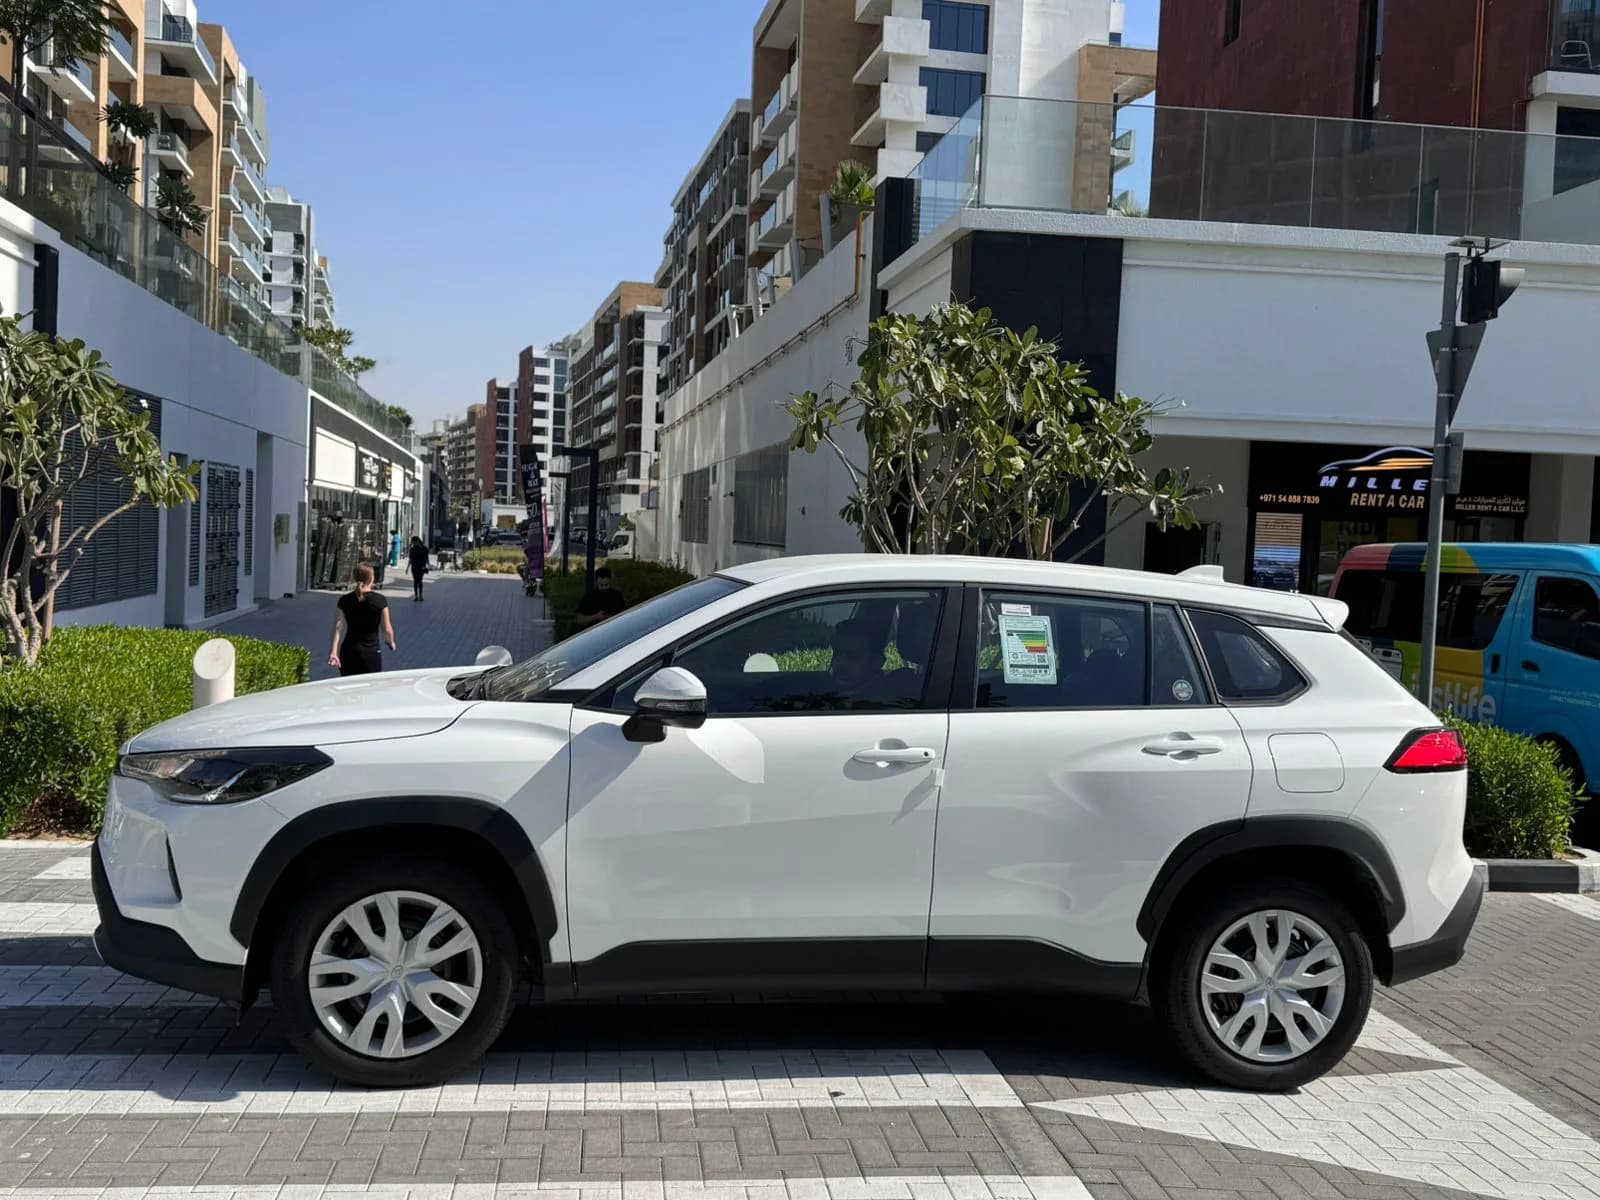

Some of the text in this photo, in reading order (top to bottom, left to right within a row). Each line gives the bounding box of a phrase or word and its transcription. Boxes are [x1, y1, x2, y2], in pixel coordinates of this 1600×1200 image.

[1319, 475, 1430, 491] MILLE
[1259, 493, 1320, 504] +971 54 888 7839
[1350, 492, 1426, 509] RENT A CAR
[1476, 504, 1493, 512] RENT
